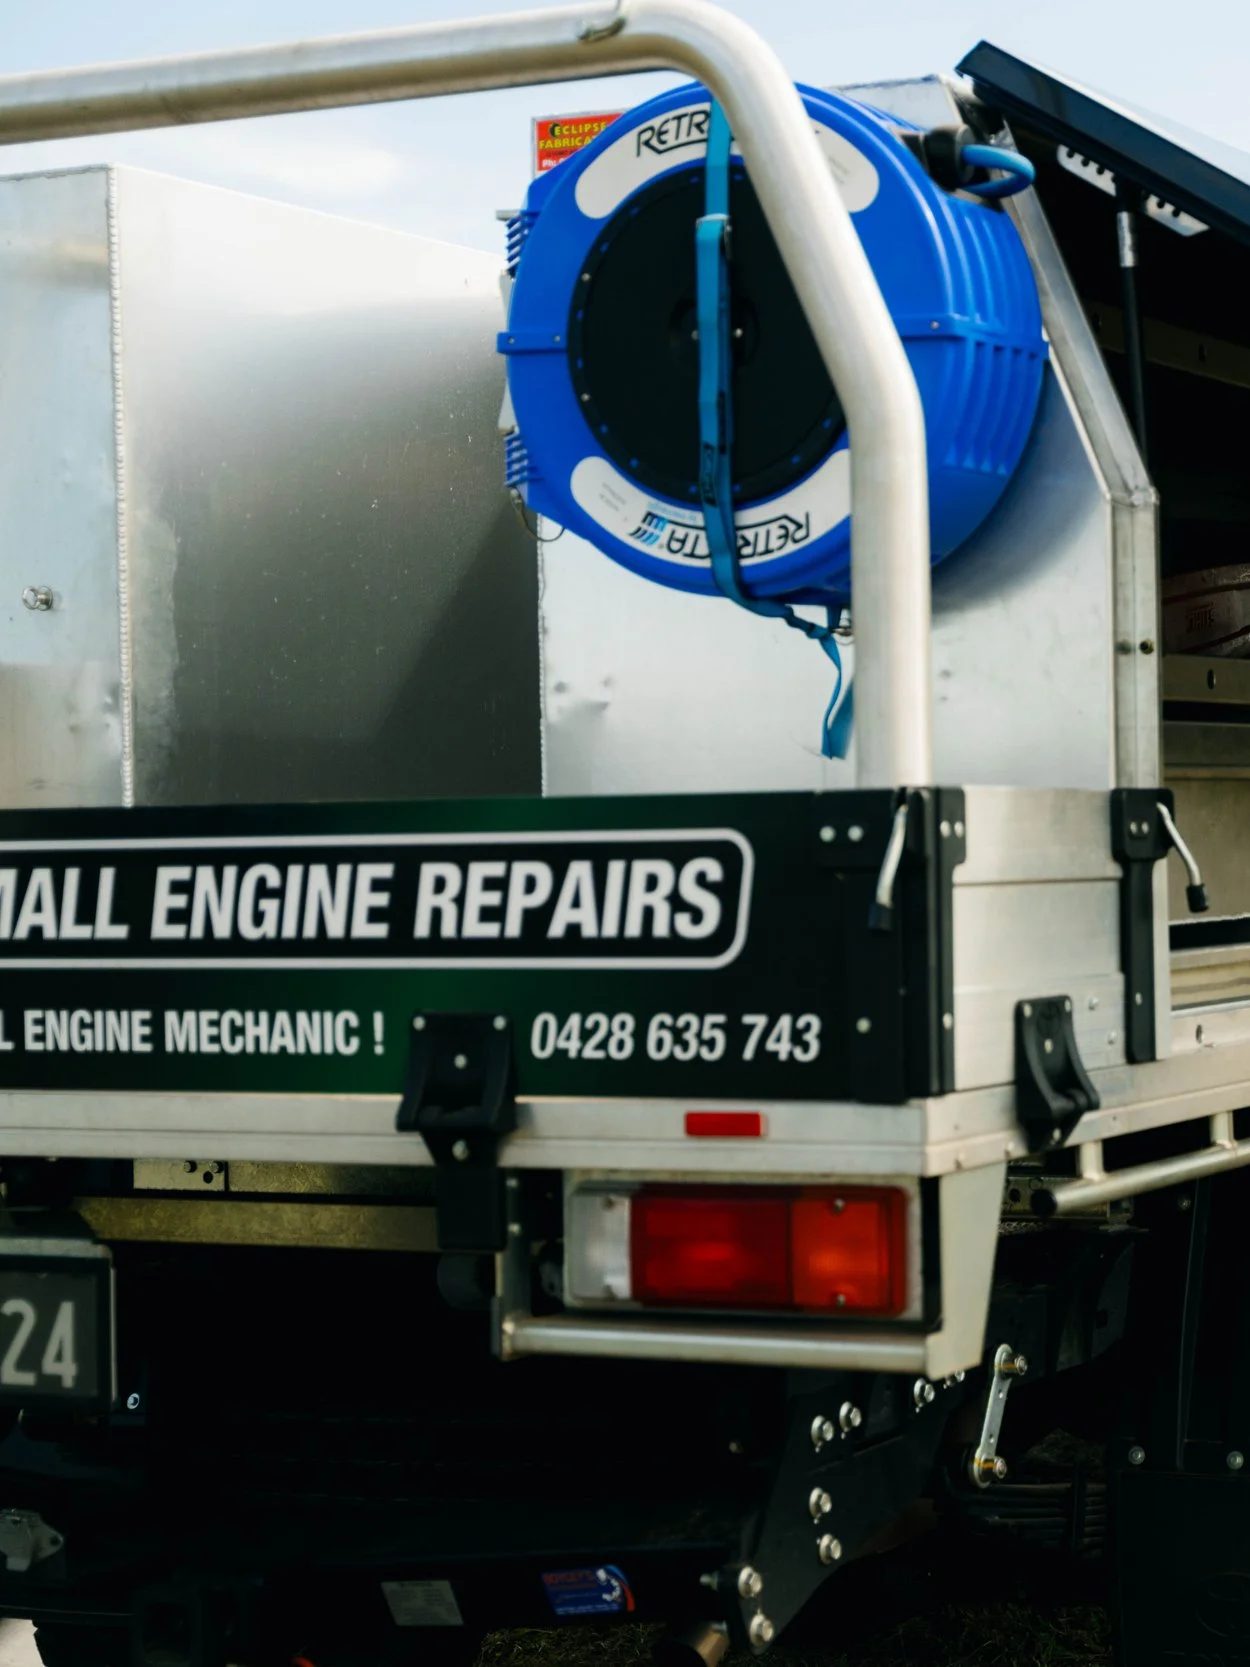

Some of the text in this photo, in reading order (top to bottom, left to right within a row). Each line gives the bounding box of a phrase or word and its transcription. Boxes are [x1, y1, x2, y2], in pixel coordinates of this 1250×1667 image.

[151, 863, 395, 939] ENGINE
[413, 859, 725, 940] REPAIRS
[23, 1009, 153, 1053] ENGINE
[163, 1009, 361, 1056] MECHANIC
[530, 1011, 821, 1062] 0428 635 743
